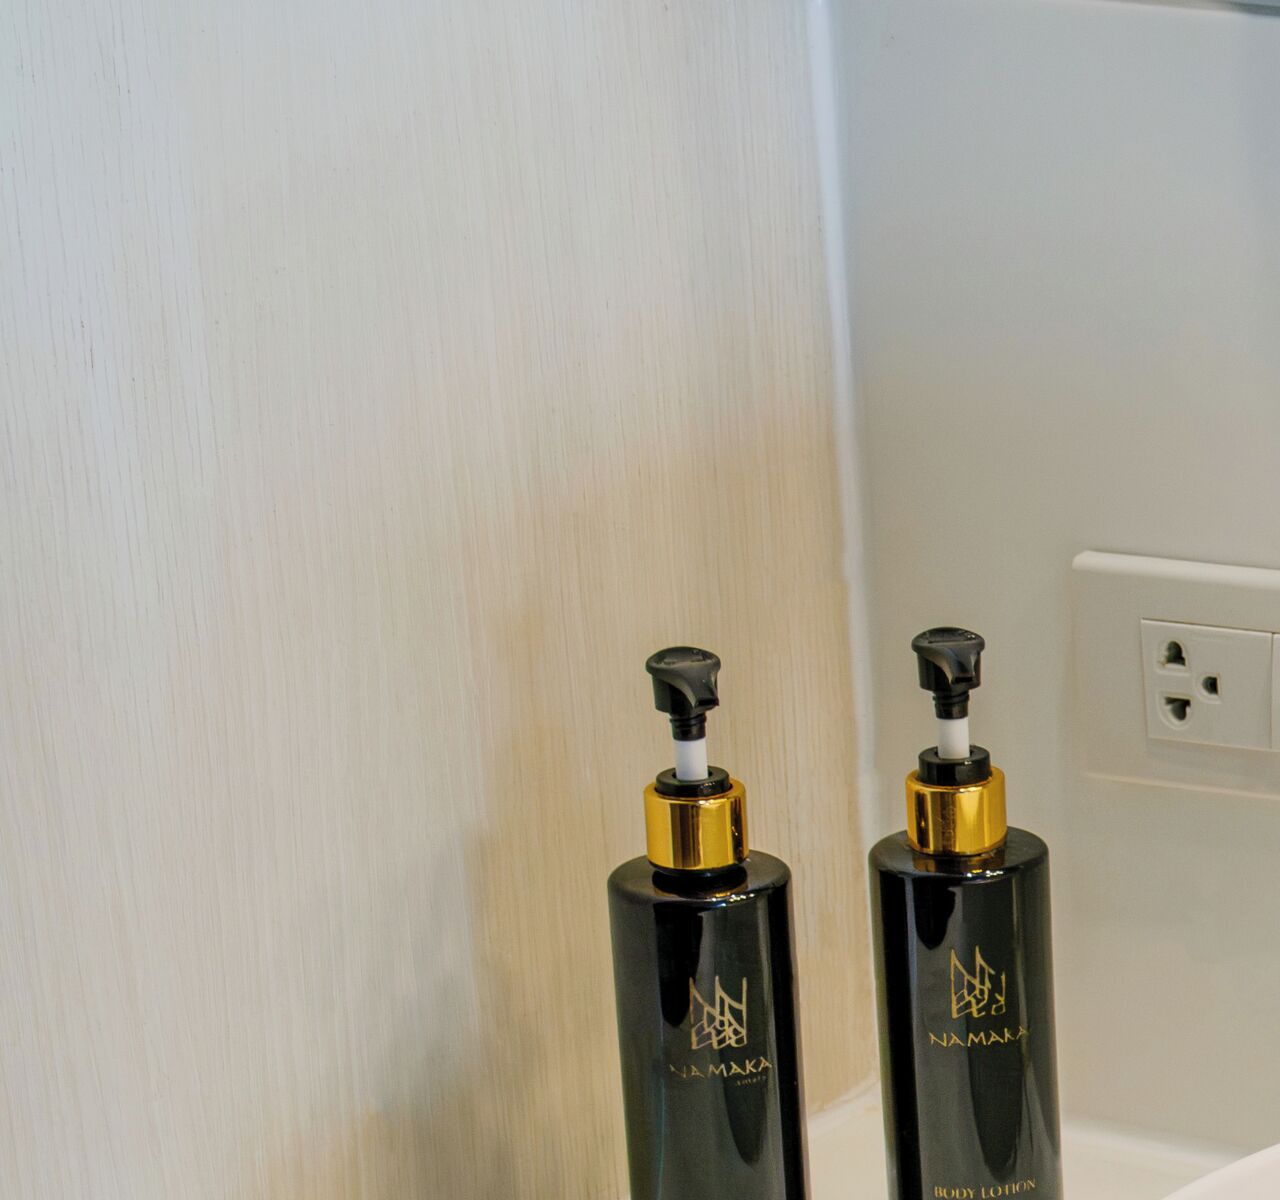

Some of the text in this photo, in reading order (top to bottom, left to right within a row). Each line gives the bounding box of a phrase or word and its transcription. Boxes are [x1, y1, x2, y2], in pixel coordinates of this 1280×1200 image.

[929, 1025, 1029, 1048] NAMAKA
[668, 1056, 772, 1079] NAMAKA
[933, 1178, 1037, 1200] BODY LOTION
